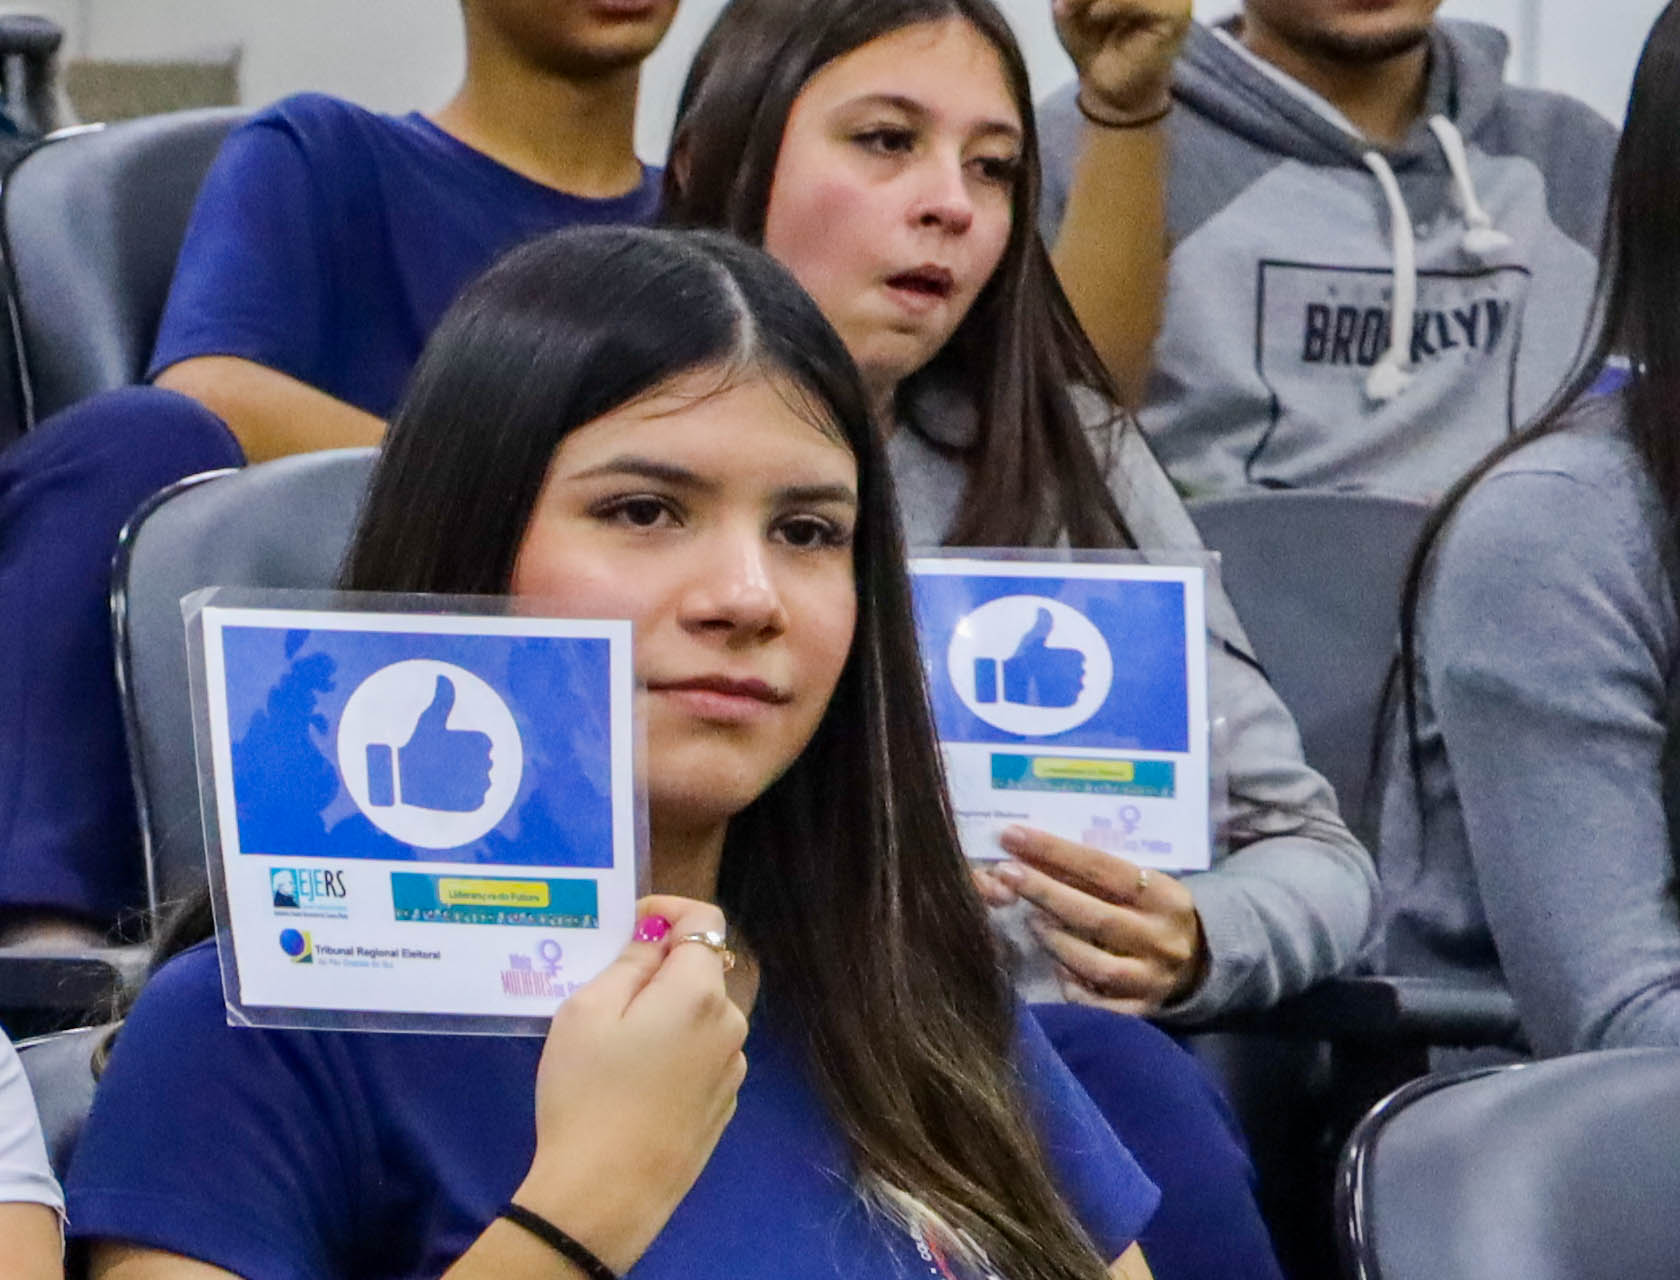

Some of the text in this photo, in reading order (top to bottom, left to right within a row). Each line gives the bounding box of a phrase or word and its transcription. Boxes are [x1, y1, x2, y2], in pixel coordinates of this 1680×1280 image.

[1302, 297, 1512, 364] BROKLYN
[297, 868, 346, 902] EJERS
[315, 944, 440, 959] Tribunal Regional Eleitoral
